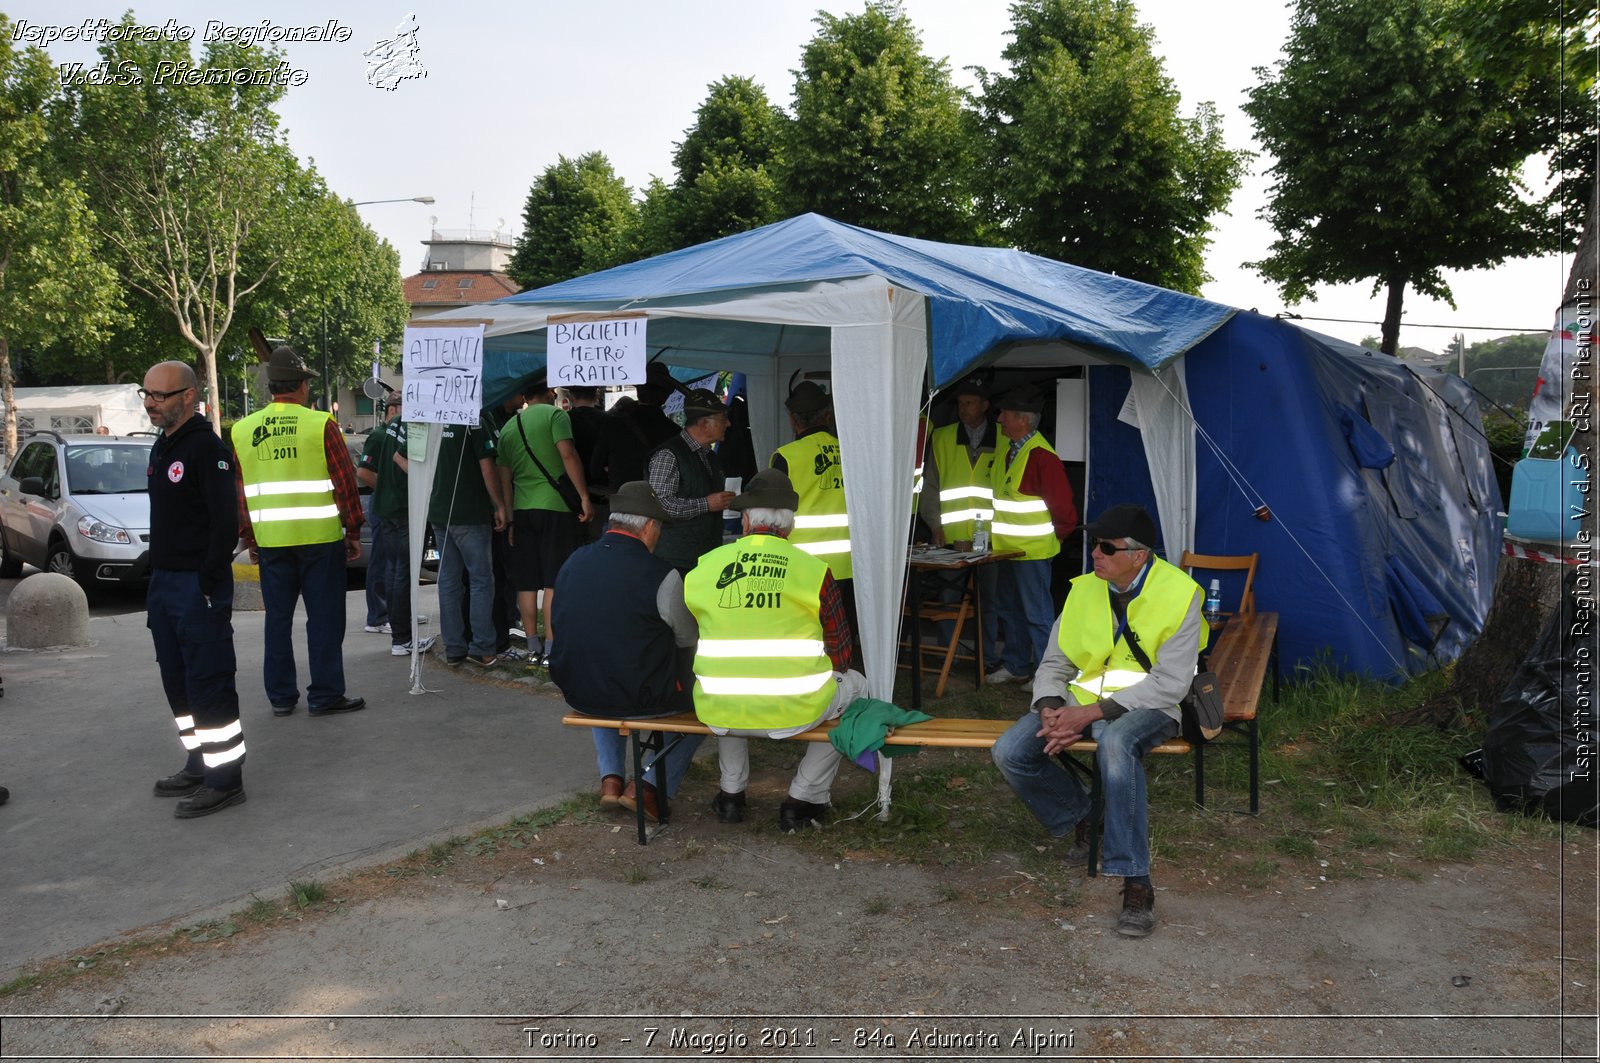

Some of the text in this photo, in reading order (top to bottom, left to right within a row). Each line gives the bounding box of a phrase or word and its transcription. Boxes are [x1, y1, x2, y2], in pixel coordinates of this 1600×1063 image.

[556, 321, 637, 344] BIGLIETTI
[410, 336, 480, 365] ATTENTI
[407, 374, 478, 404] AI FURTI
[411, 409, 425, 418] SUL
[272, 426, 297, 436] ALPINI
[274, 447, 297, 460] 2011
[761, 558, 788, 566] NAZIONALE
[763, 553, 789, 562] ADUNATA
[749, 565, 786, 578] ALPINI
[746, 578, 784, 591] TORINO
[744, 592, 781, 608] 2011
